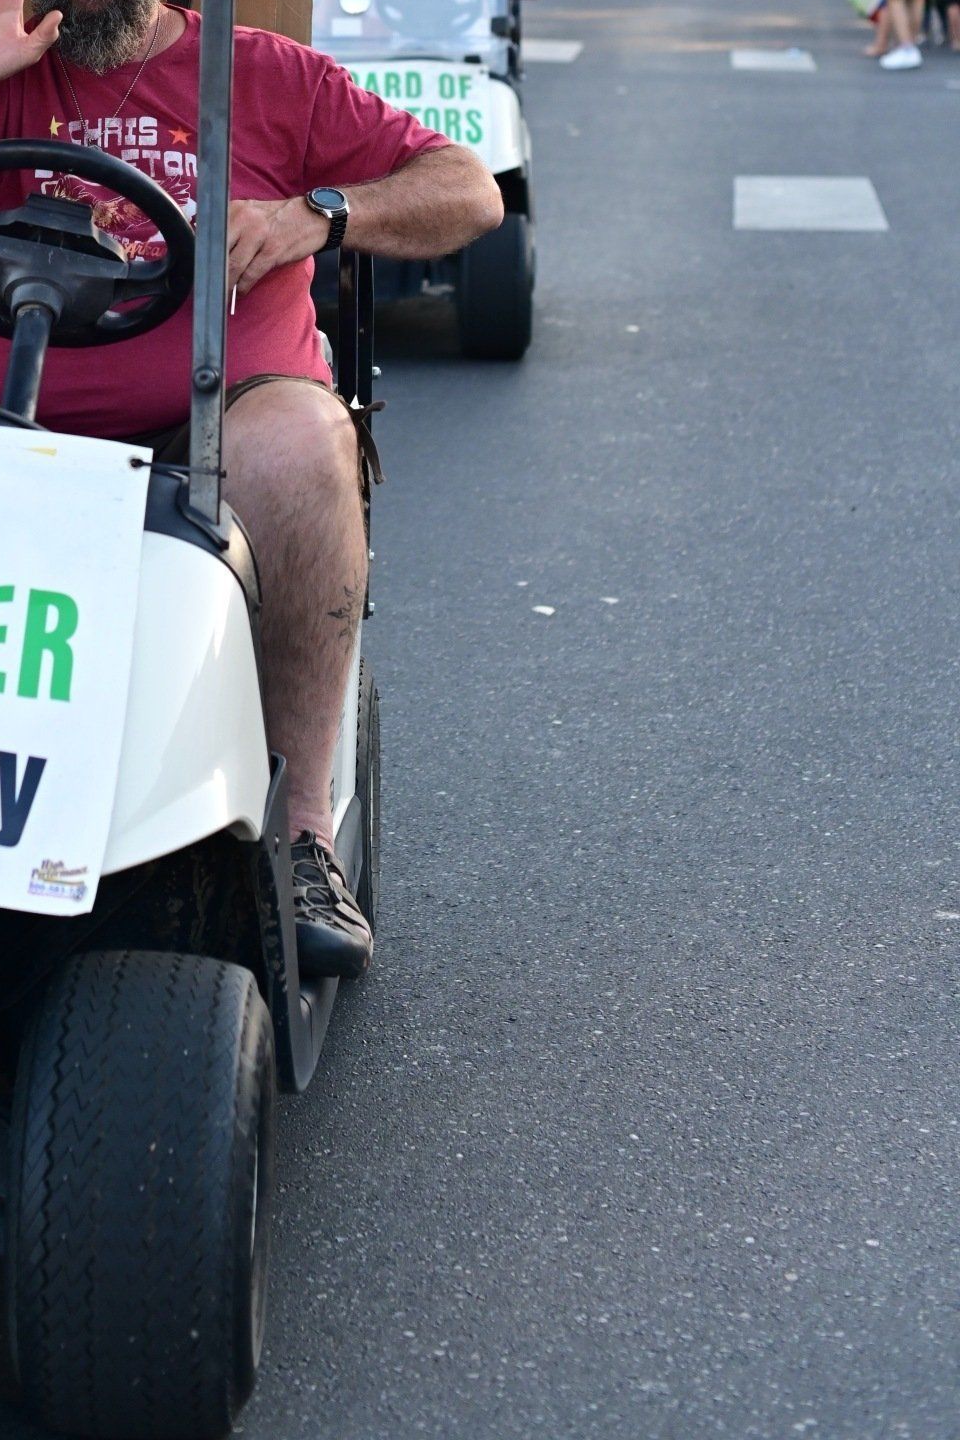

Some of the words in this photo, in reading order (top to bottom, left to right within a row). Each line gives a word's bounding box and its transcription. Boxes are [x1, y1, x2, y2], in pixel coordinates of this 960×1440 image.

[352, 71, 423, 99] ARD
[438, 73, 472, 100] OF
[68, 116, 158, 148] CHRIS
